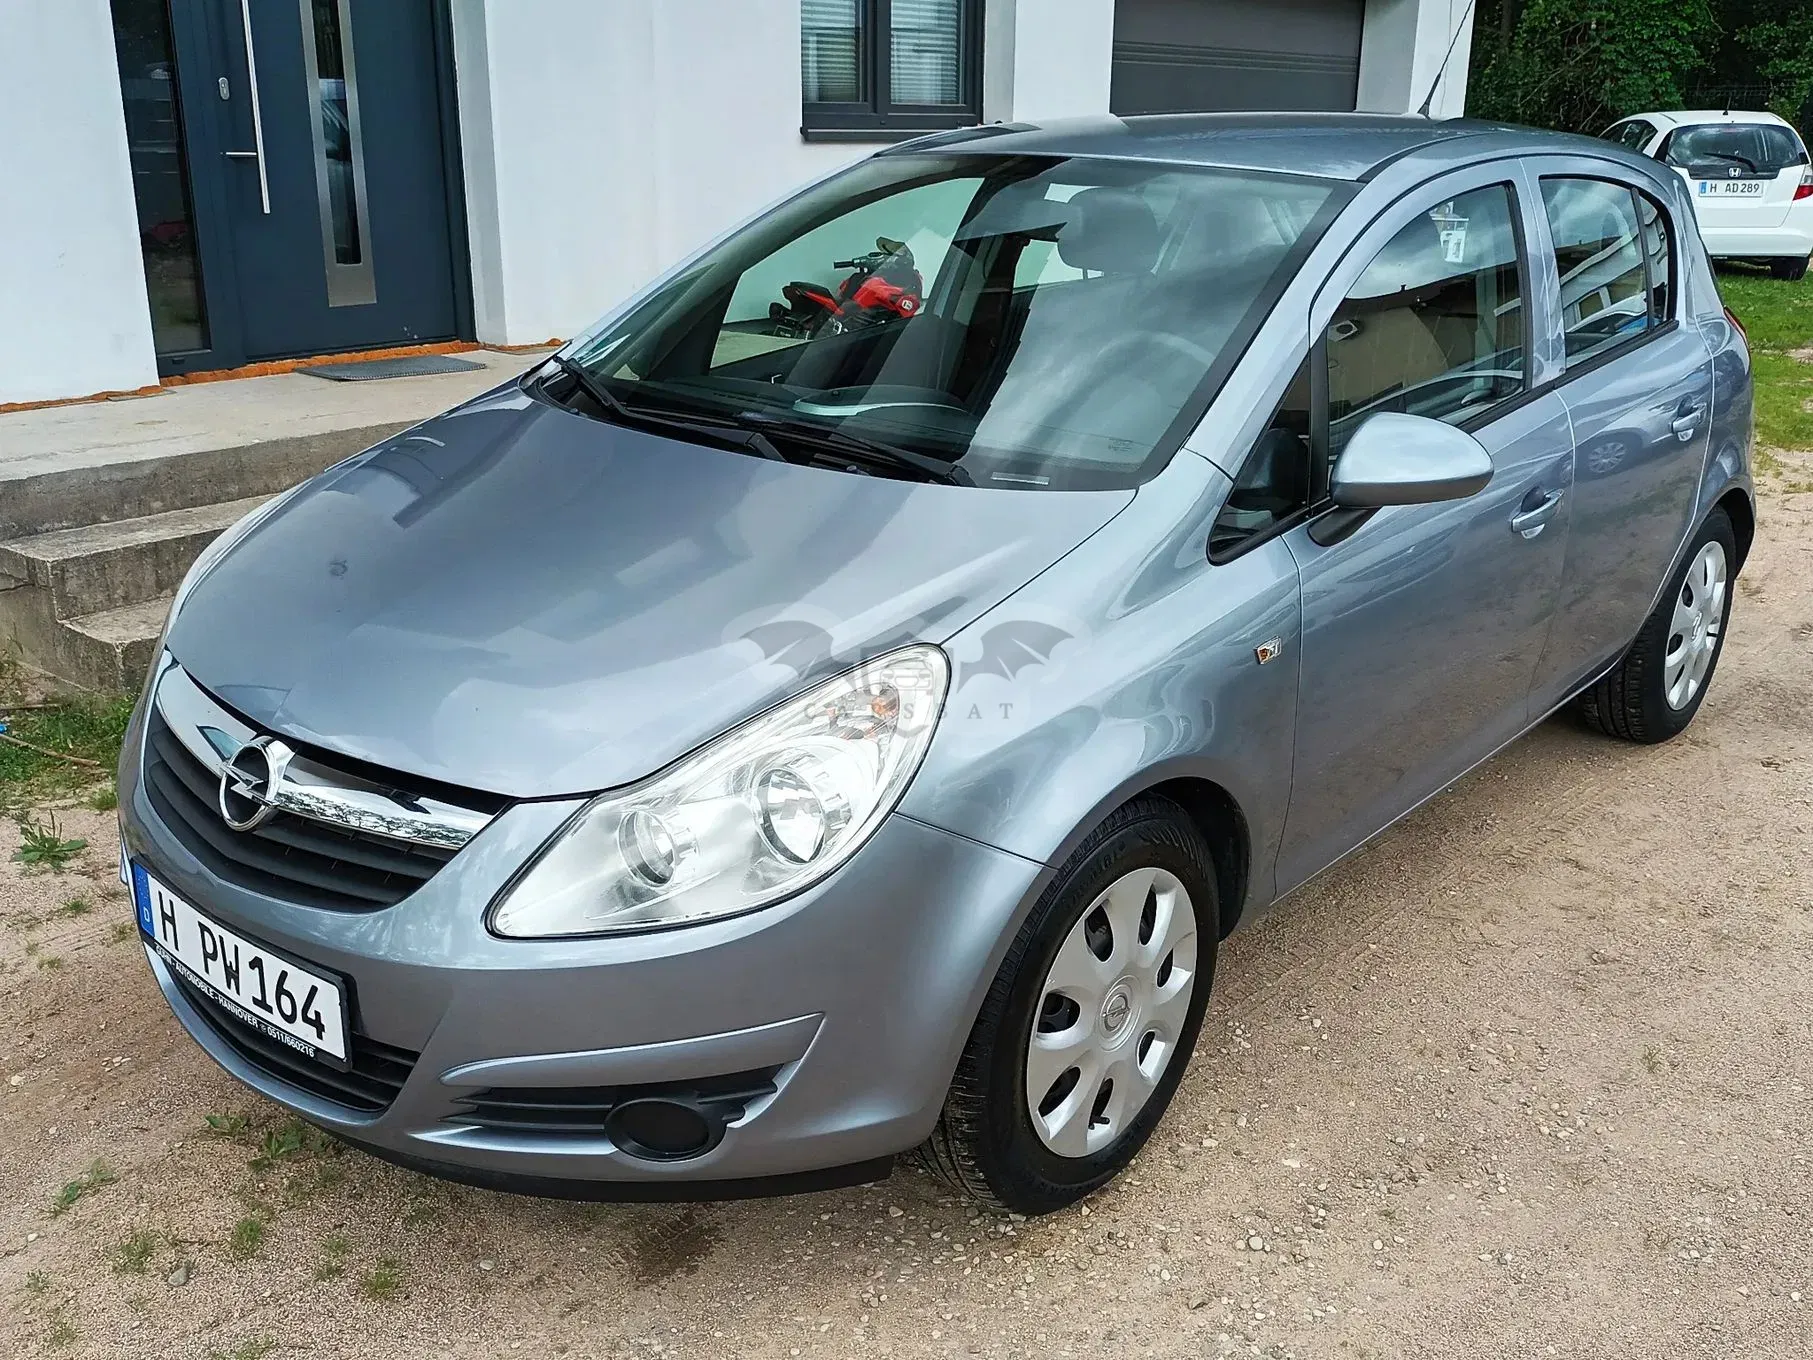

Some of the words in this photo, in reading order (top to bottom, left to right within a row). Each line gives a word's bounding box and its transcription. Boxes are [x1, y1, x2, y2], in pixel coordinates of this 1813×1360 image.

[1710, 184, 1717, 193] H
[143, 906, 150, 923] D
[158, 890, 179, 951] H
